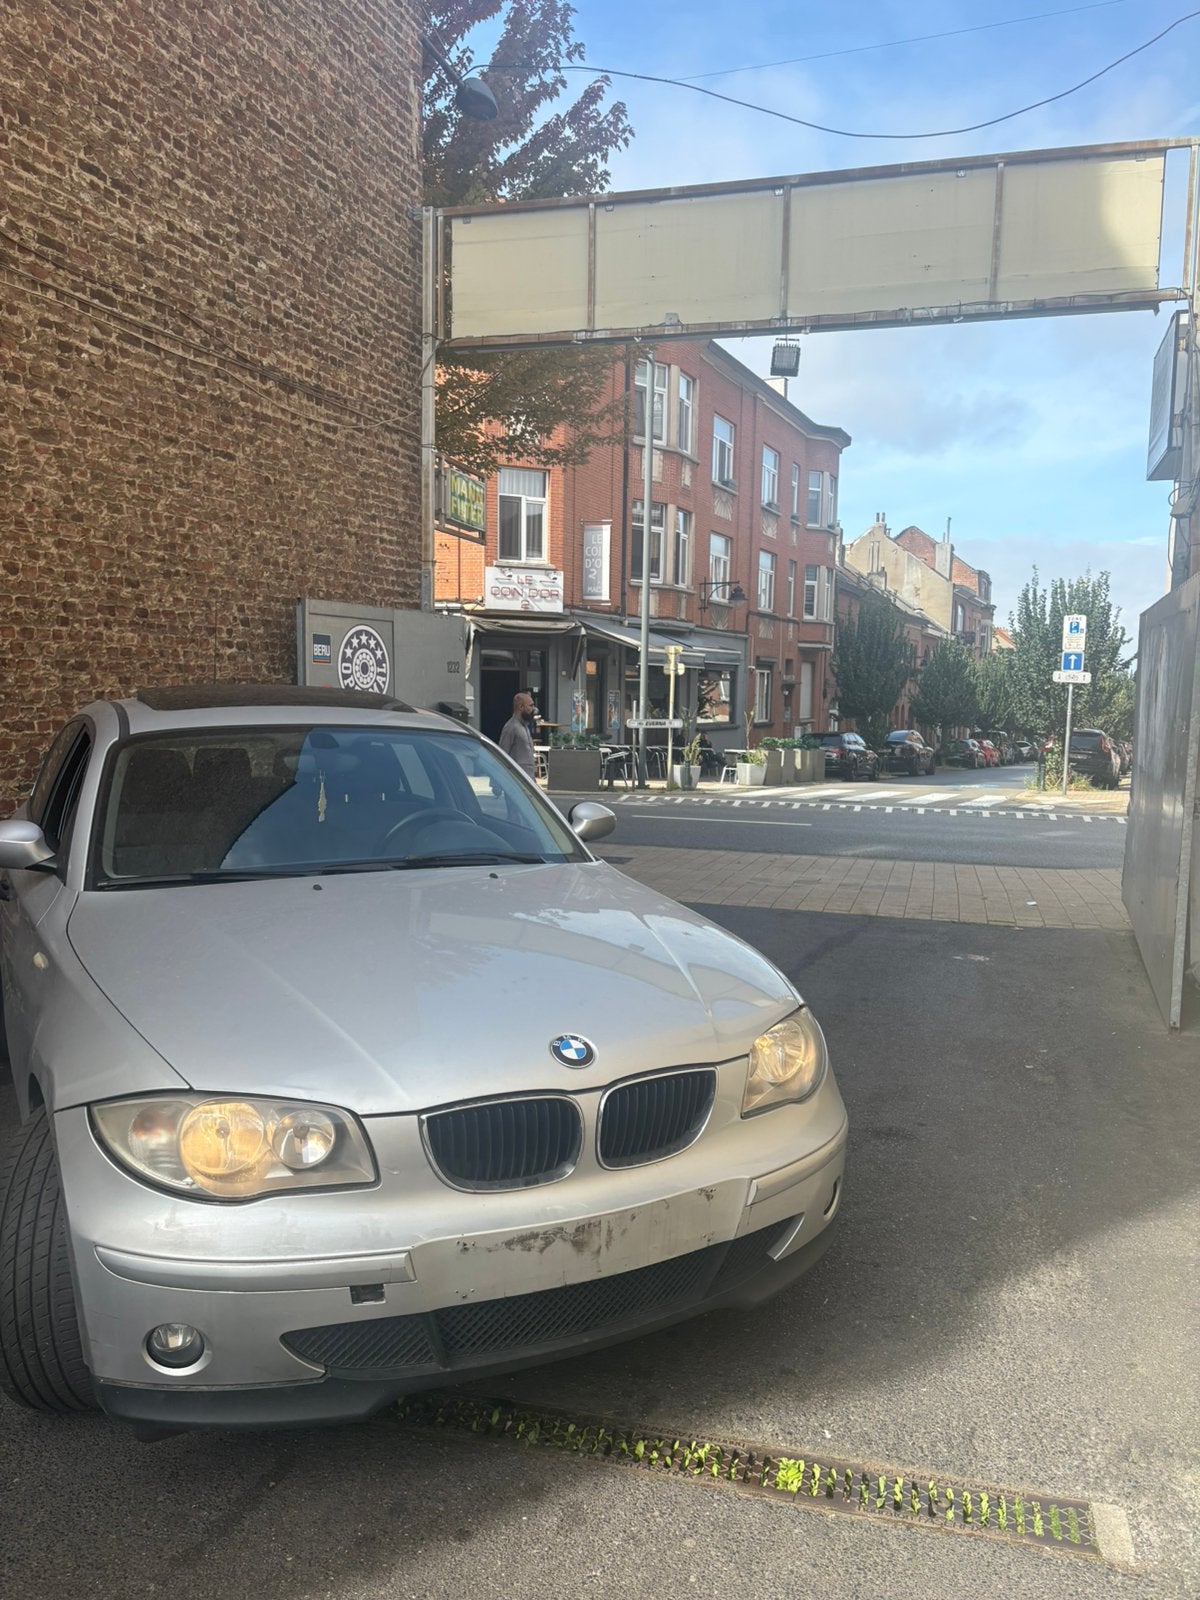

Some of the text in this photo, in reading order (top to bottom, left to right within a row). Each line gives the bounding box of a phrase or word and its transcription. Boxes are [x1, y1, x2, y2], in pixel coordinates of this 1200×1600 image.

[451, 475, 484, 502] MANN
[450, 496, 483, 527] FILTER
[592, 533, 603, 544] LE
[585, 546, 603, 556] COI
[585, 558, 602, 568] D'O
[517, 575, 533, 585] LE
[528, 588, 559, 599] D'OR
[520, 600, 530, 609] 2
[313, 643, 331, 657] BERU
[552, 1035, 585, 1046] BMW
